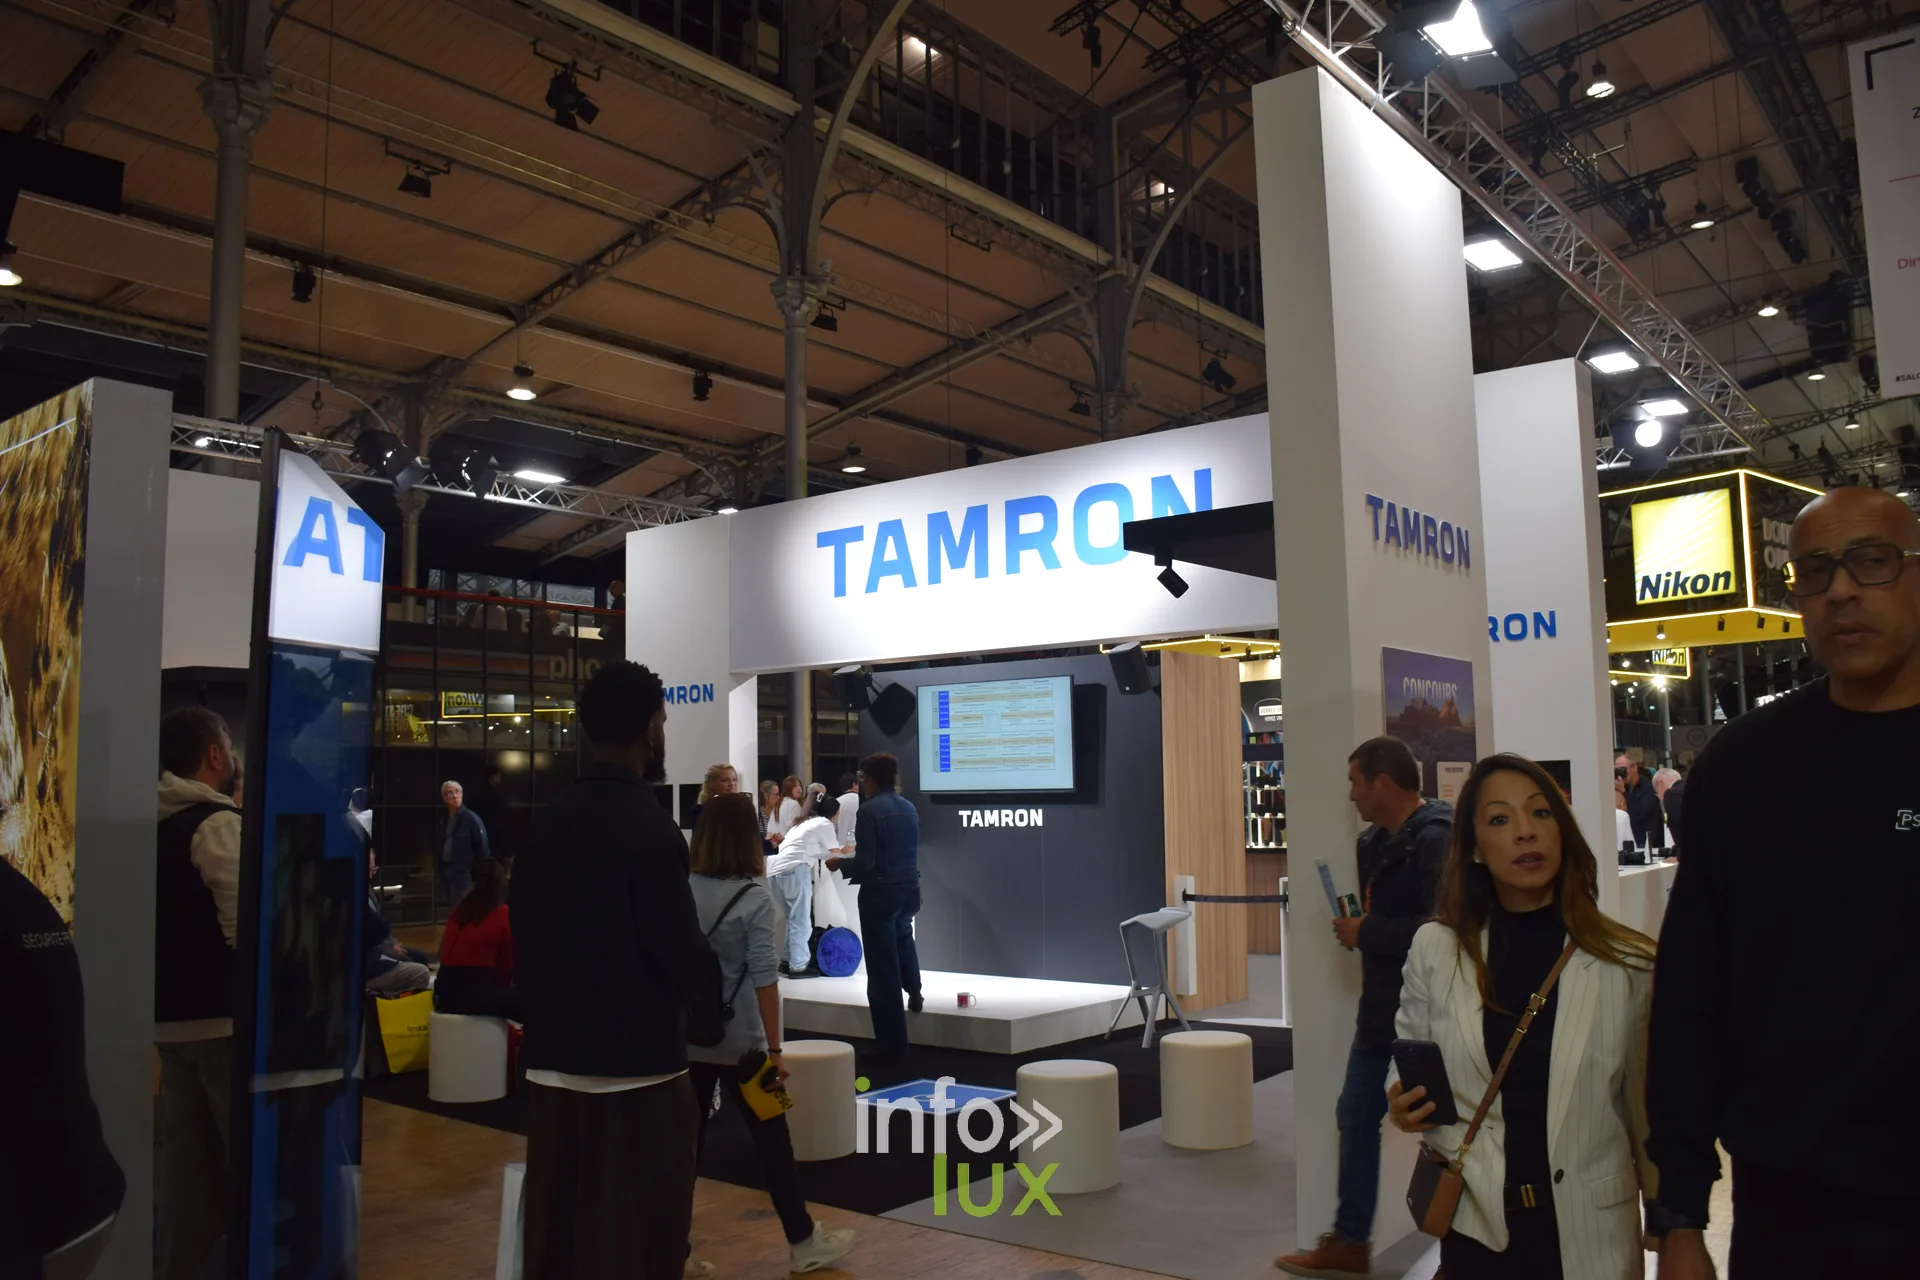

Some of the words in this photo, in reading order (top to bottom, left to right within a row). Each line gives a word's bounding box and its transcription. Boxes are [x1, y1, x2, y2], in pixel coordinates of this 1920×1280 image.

[1366, 493, 1471, 569] TAMRON
[1638, 570, 1731, 601] Nikon
[1403, 676, 1458, 702] CONCOURS
[958, 809, 1043, 827] TAMRON
